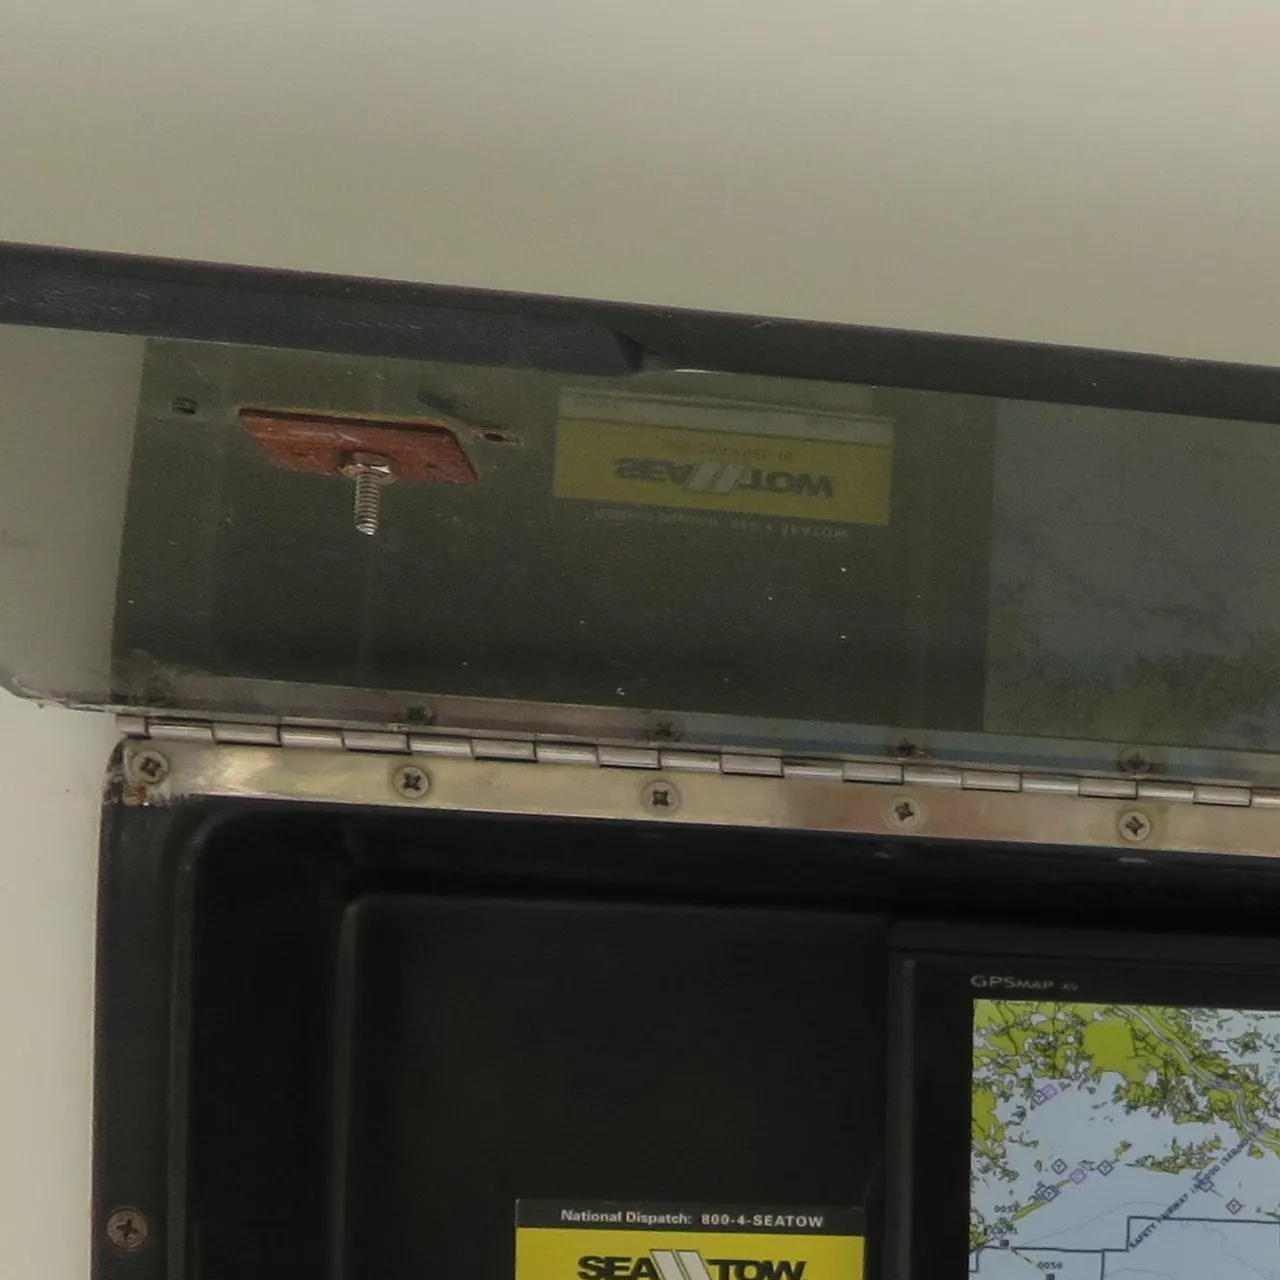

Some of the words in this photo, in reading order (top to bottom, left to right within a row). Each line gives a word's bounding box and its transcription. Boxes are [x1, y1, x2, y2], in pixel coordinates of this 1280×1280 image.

[561, 1208, 622, 1223] National
[626, 1211, 692, 1226] Dispatch:
[701, 1213, 824, 1228] 800-4-SEATOW
